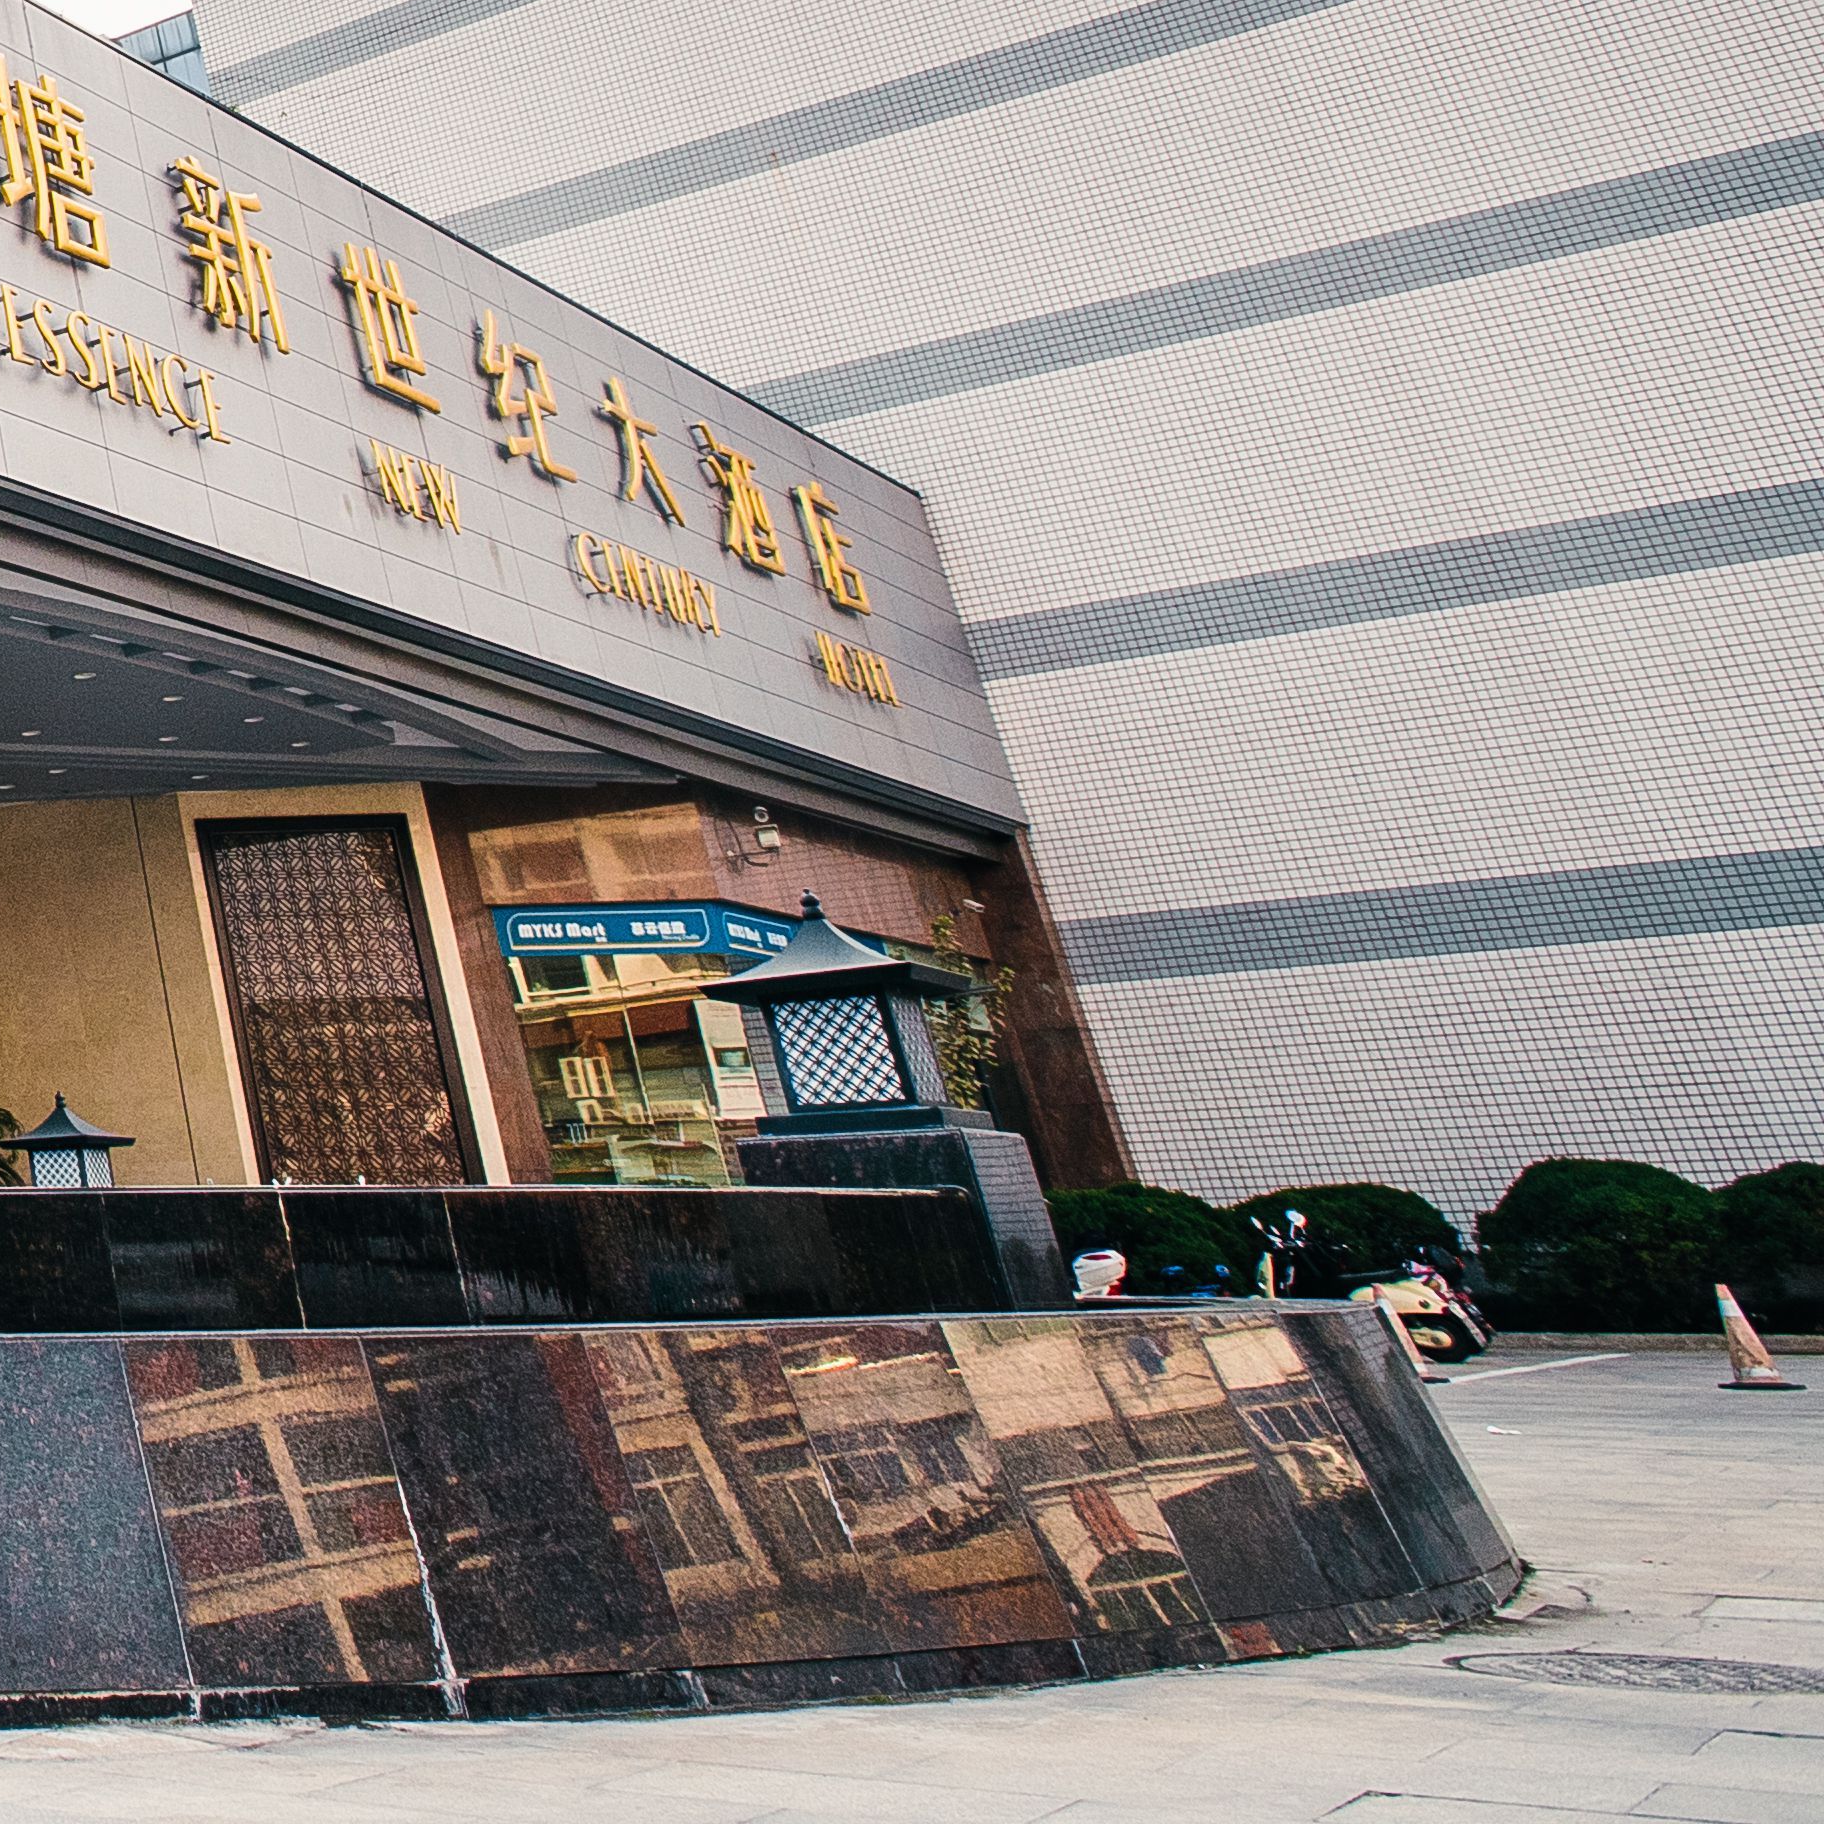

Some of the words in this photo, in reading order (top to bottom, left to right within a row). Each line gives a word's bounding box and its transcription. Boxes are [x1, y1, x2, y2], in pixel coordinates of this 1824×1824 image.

[369, 438, 460, 534] NEW
[574, 531, 721, 637] CENTURY
[814, 629, 902, 708] HOTEL
